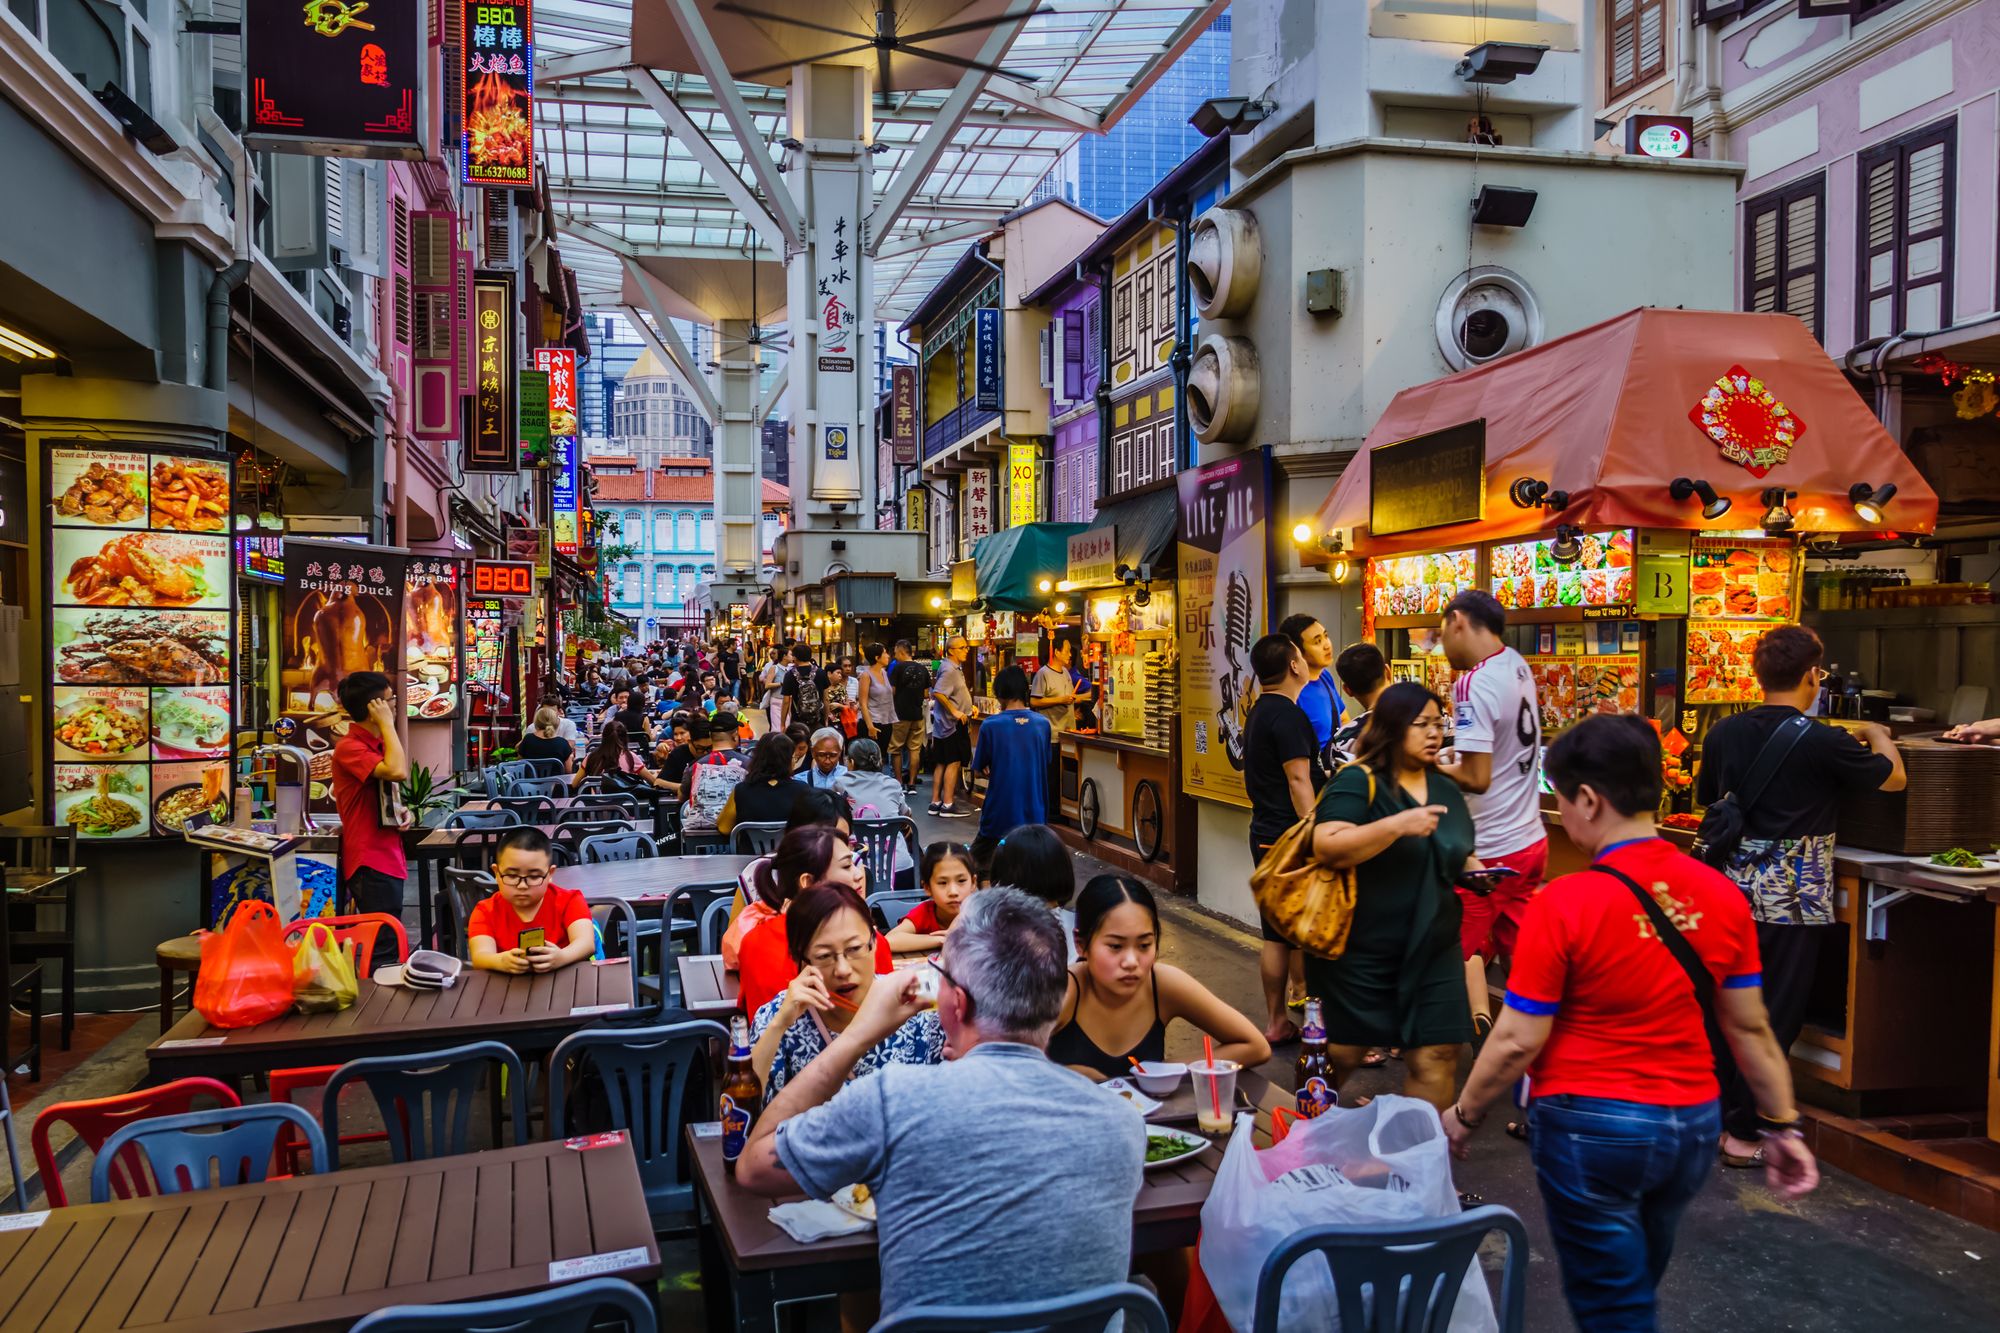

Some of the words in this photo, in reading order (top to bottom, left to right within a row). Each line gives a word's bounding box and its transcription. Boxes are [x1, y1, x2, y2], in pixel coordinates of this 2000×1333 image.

[477, 7, 516, 26] BBQ
[473, 25, 523, 49] 棒棒
[468, 165, 526, 179] TEL:63270688
[55, 450, 74, 458] Sweet
[109, 453, 128, 461] Spare
[828, 448, 846, 458] Tiger
[1013, 466, 1032, 479] XO
[971, 471, 988, 536] 新聲詩社
[1186, 496, 1216, 538] LIVE
[1227, 486, 1253, 530] MIC
[306, 562, 386, 584] 北京烤鸭
[476, 566, 530, 592] BBQ
[300, 579, 352, 595] Beijing
[358, 584, 393, 596] Duck
